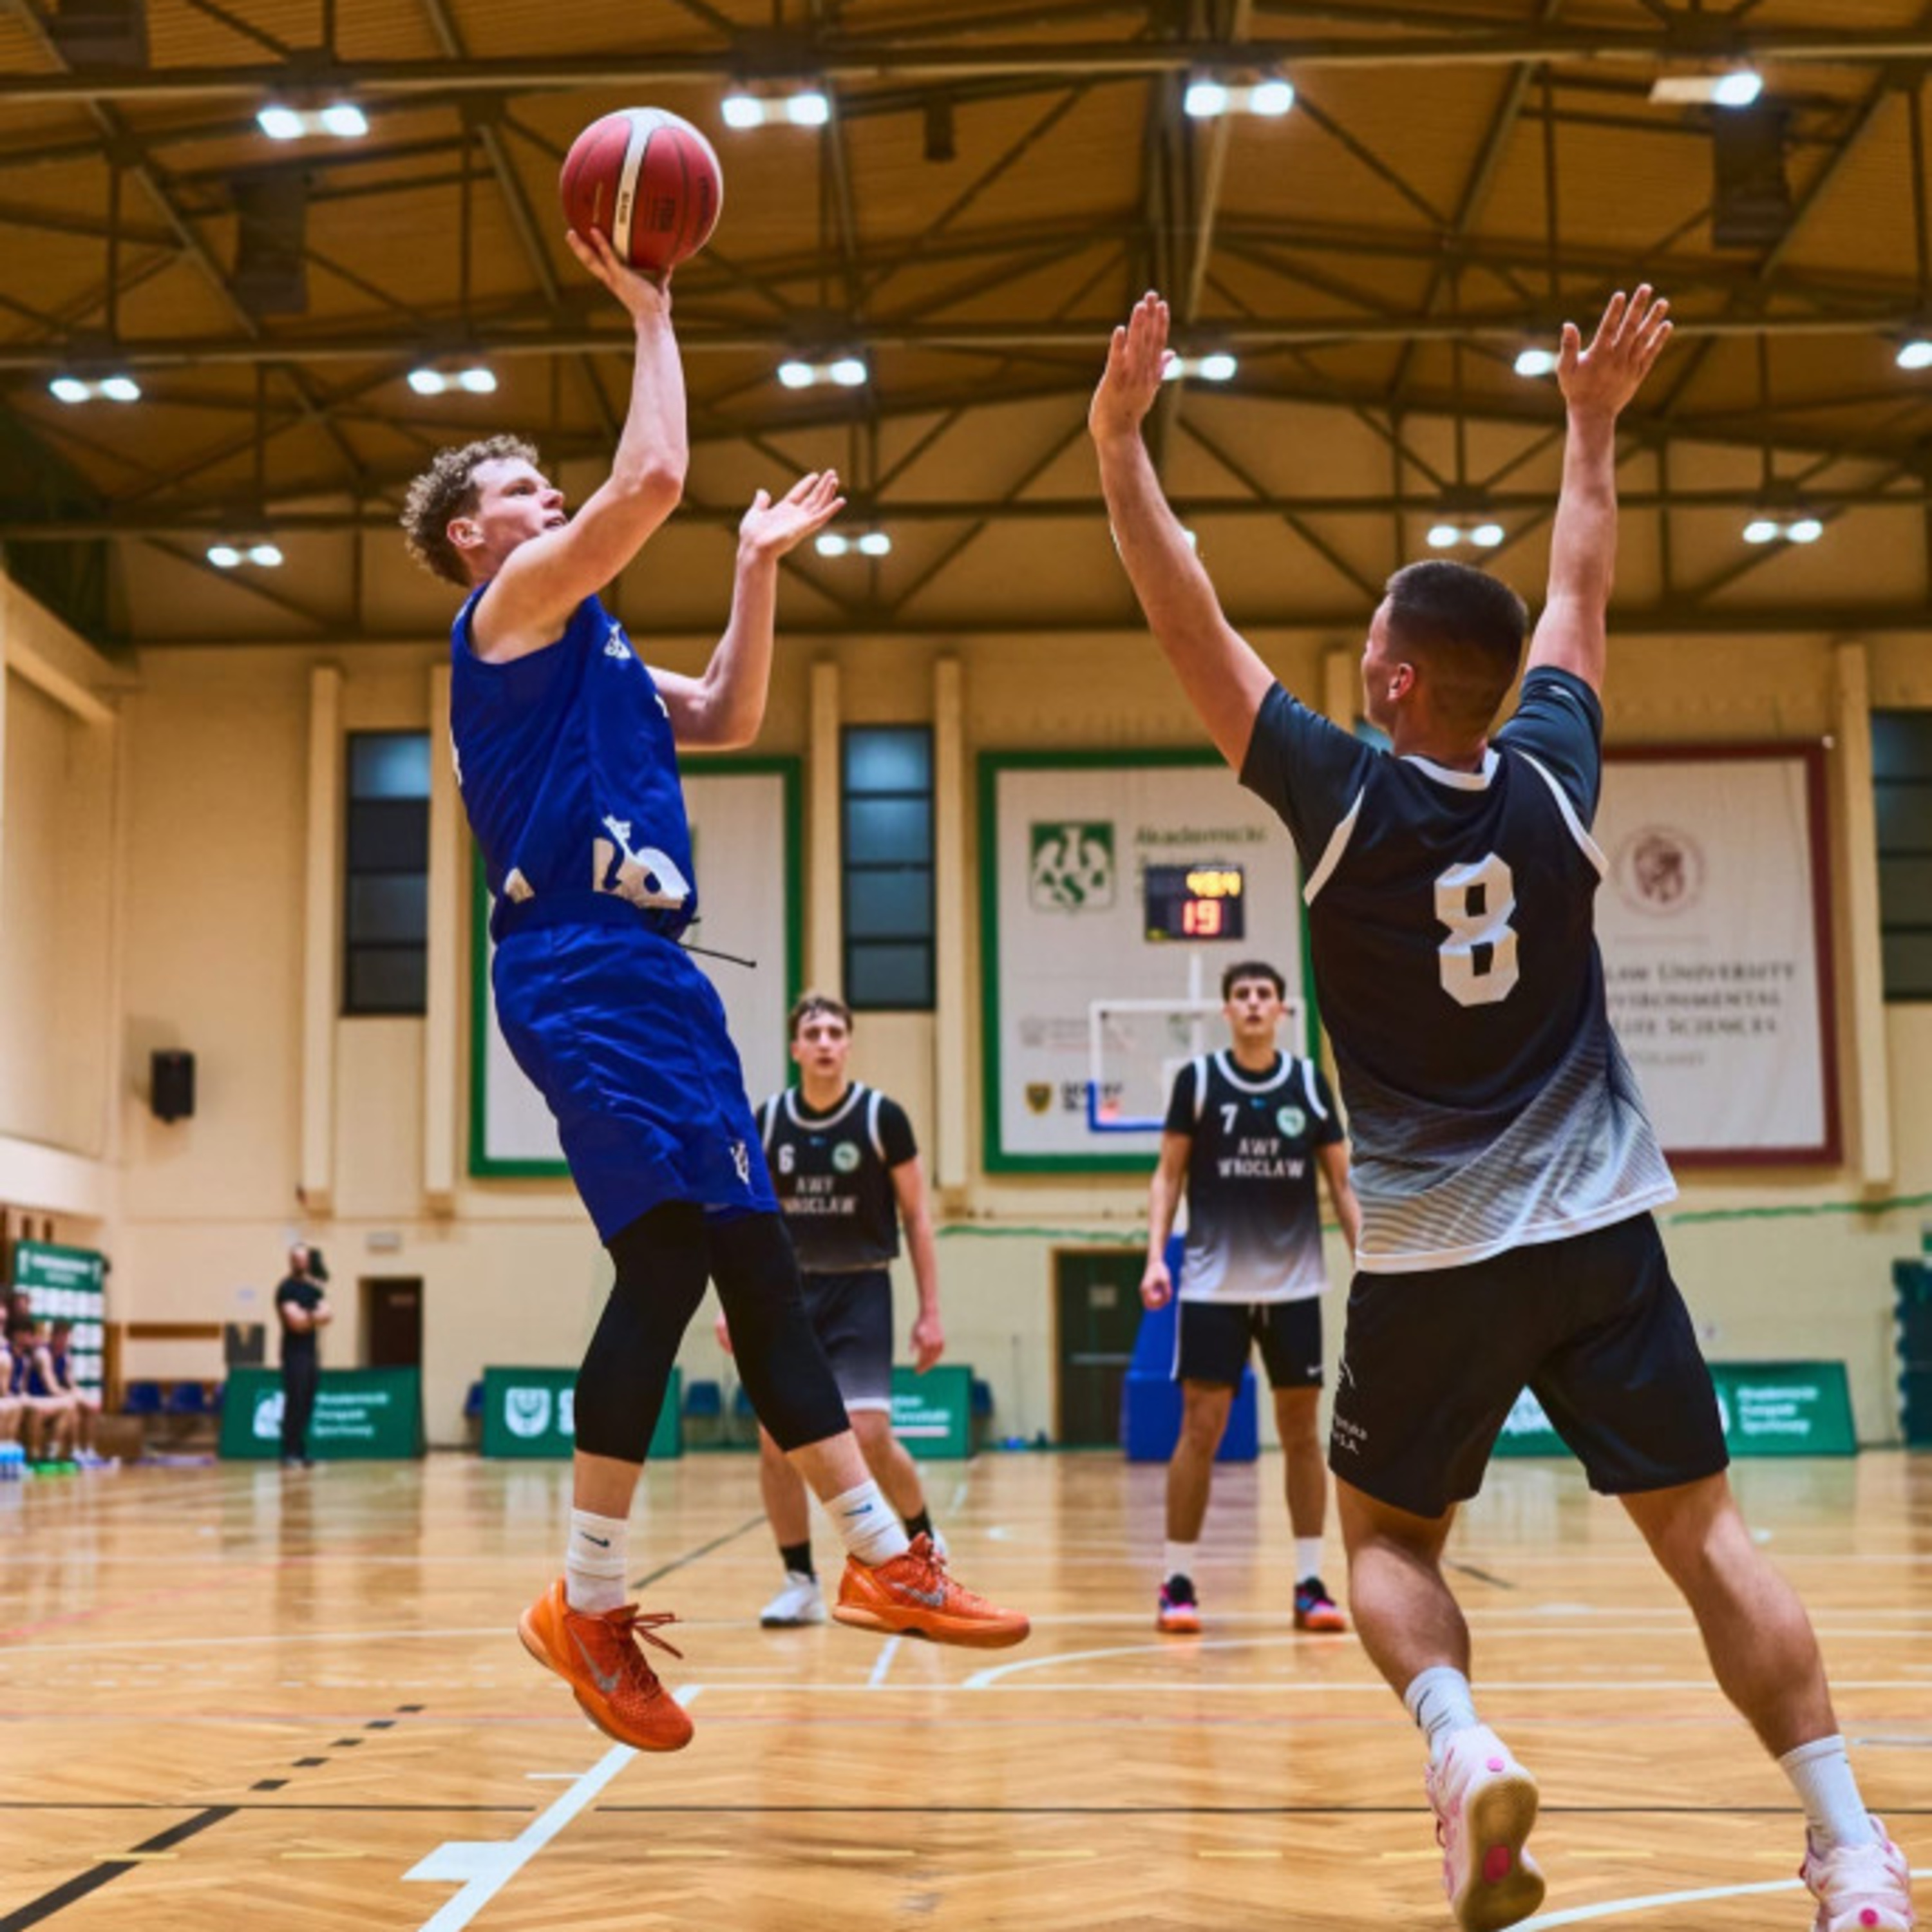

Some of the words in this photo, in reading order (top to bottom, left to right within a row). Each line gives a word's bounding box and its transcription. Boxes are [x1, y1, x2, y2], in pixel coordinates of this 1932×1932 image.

[1184, 900, 1222, 934] 19
[1434, 851, 1520, 1007] 8
[1220, 1103, 1238, 1134] 7
[779, 1144, 795, 1174] 6
